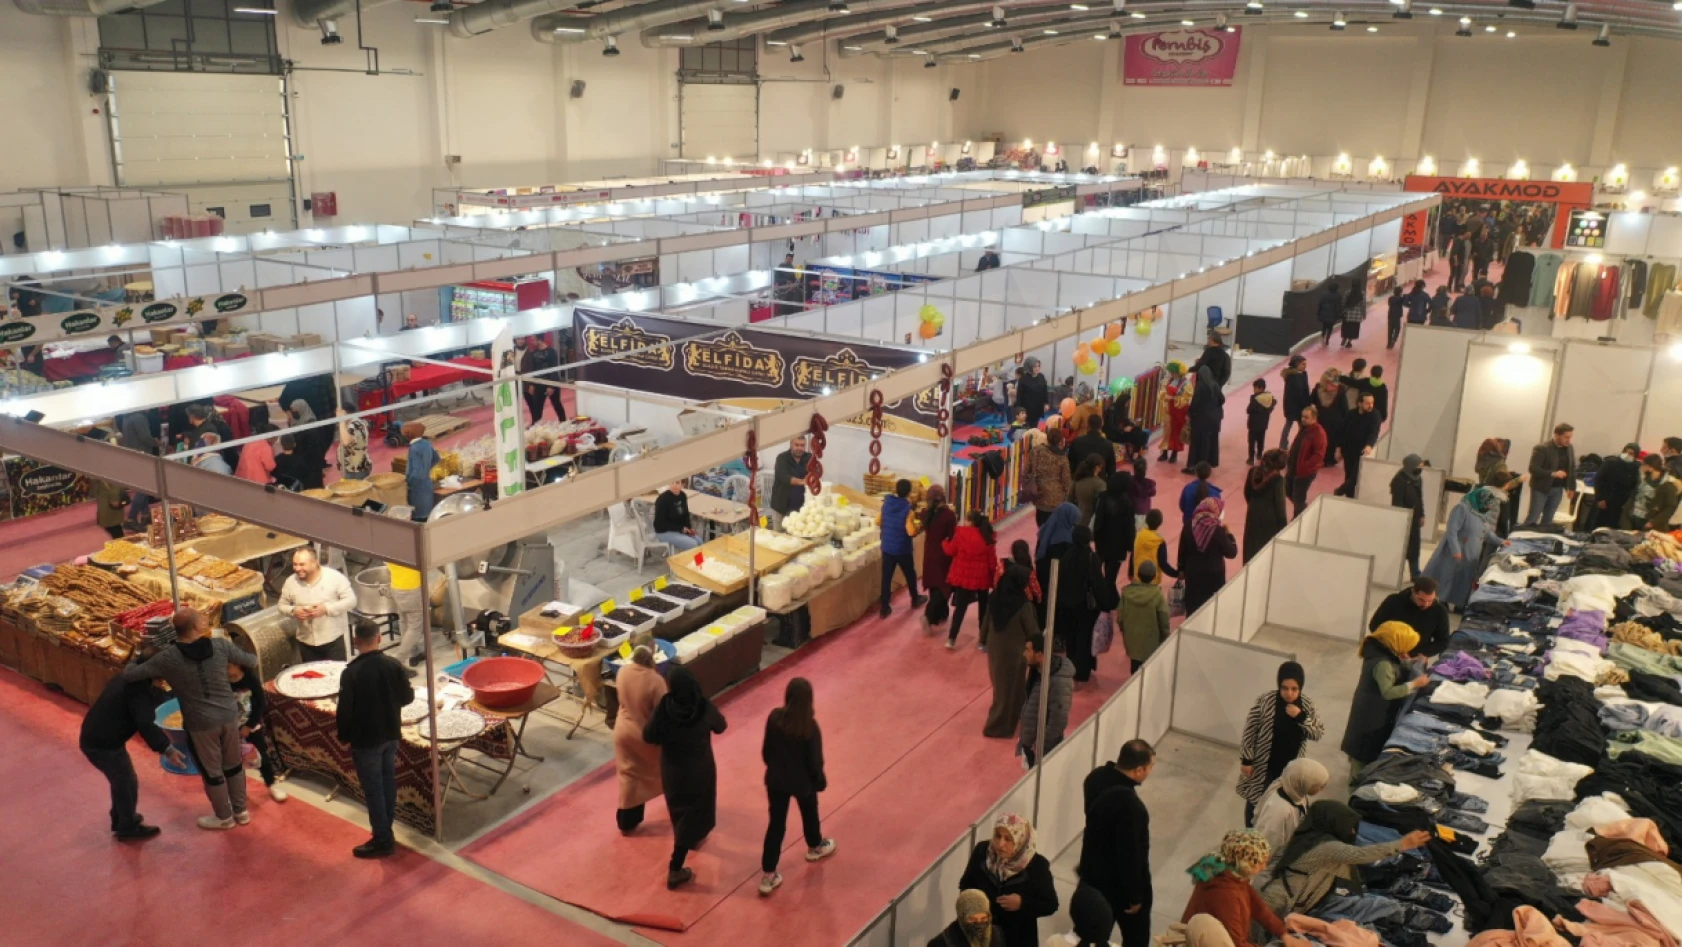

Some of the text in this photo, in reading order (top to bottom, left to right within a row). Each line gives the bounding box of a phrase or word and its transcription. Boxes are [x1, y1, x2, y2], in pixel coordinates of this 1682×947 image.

[1434, 181, 1561, 197] AYAKMOD
[1402, 213, 1417, 244] AKMO
[25, 472, 73, 487] Hakanlar
